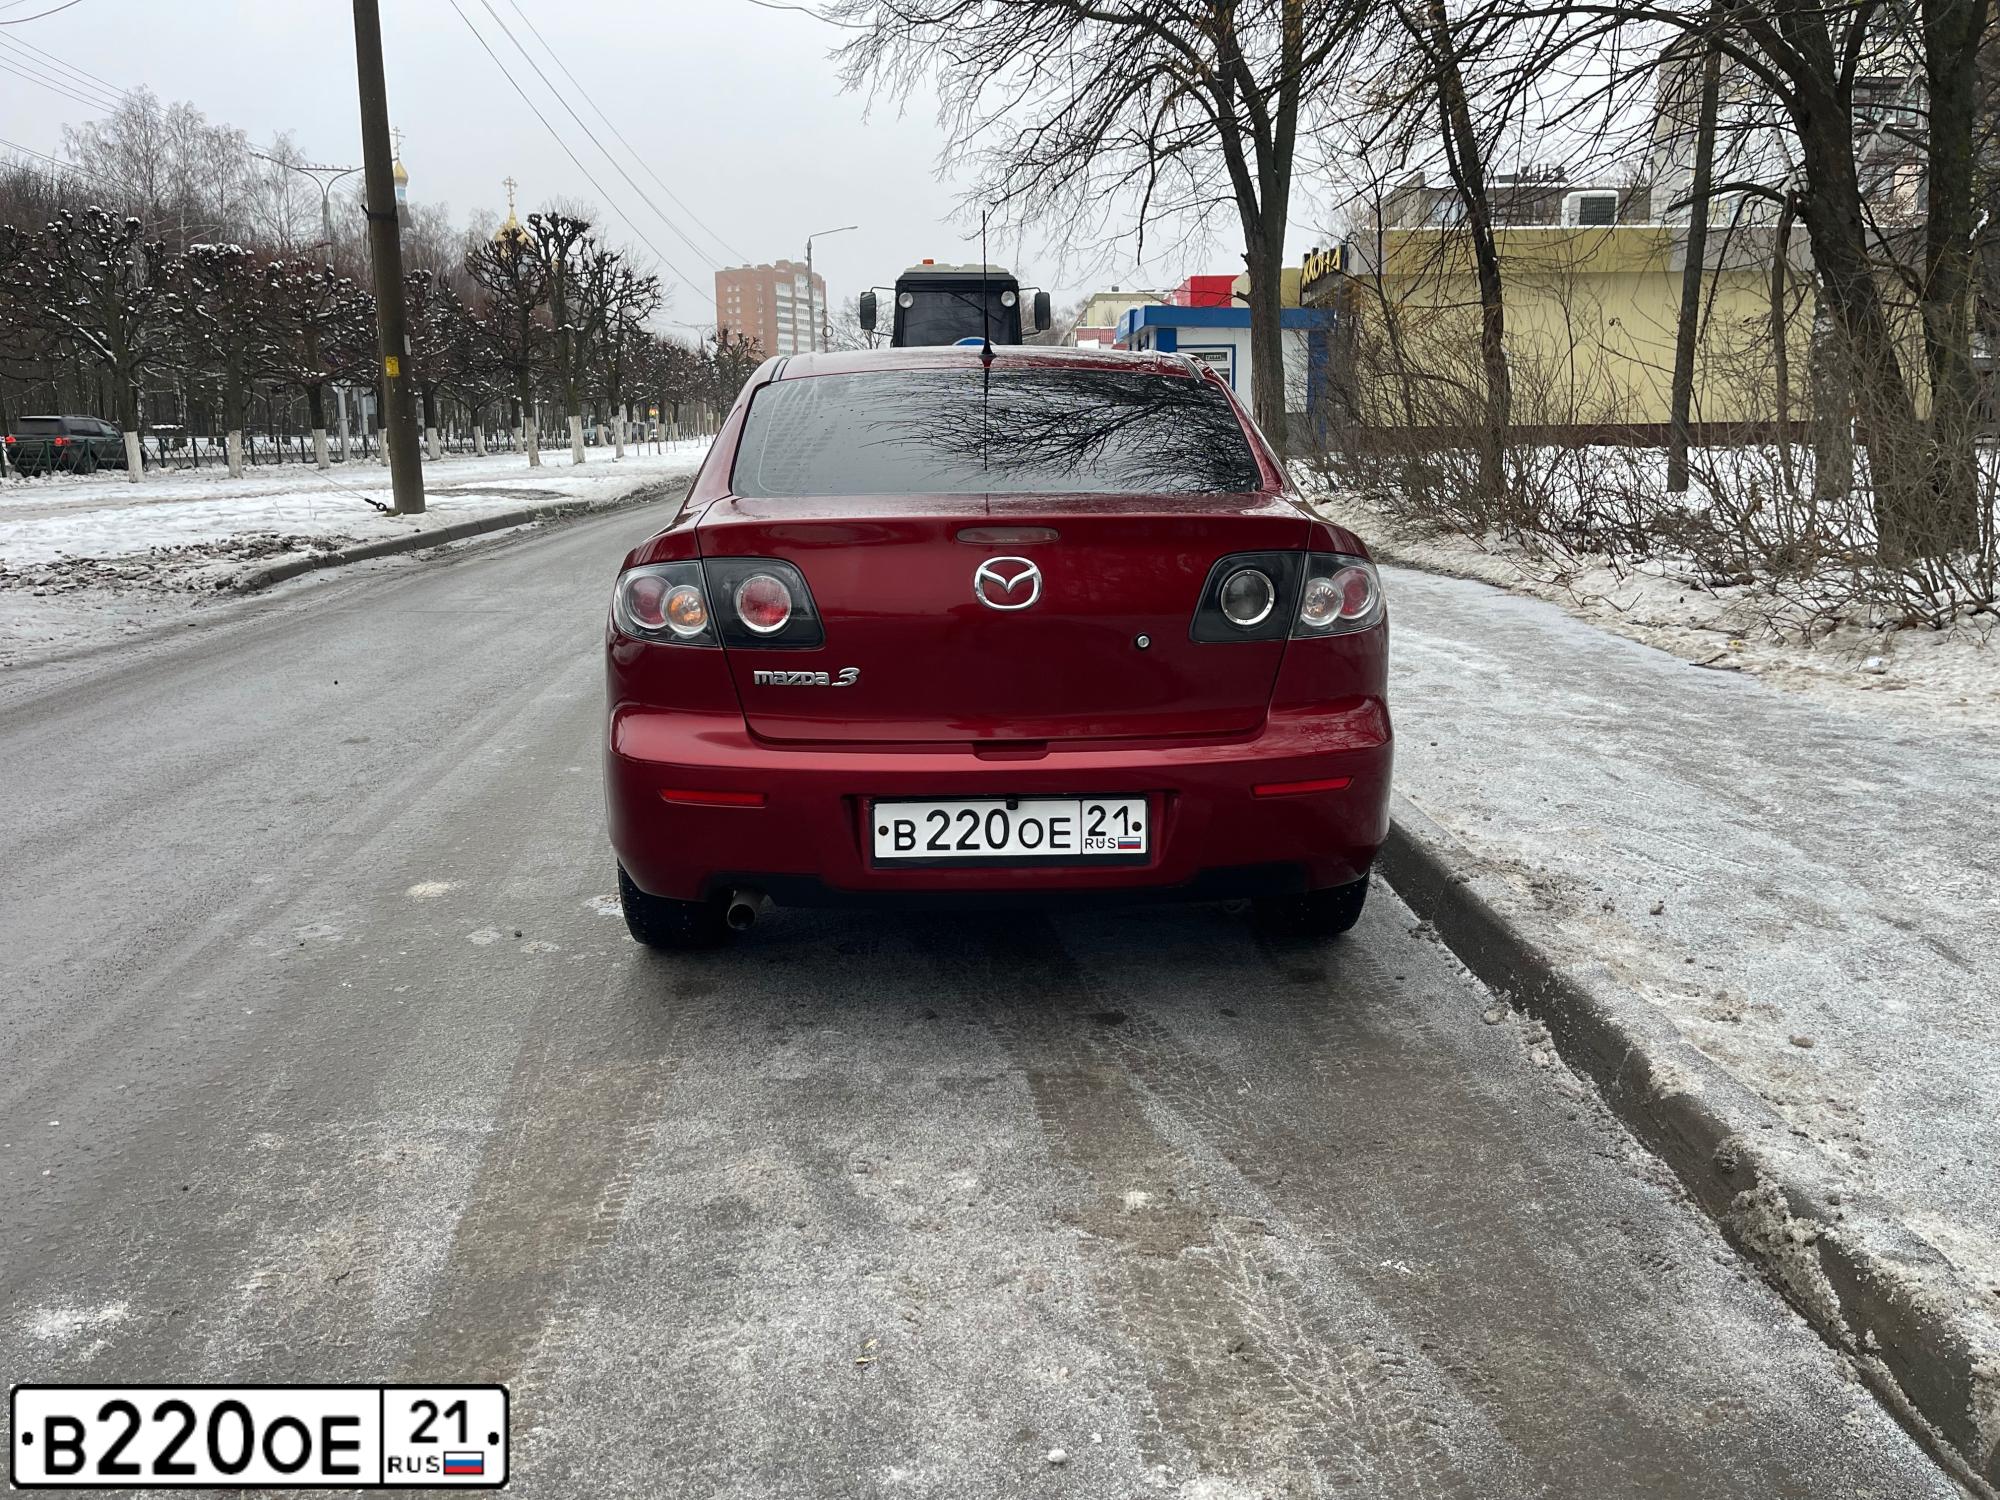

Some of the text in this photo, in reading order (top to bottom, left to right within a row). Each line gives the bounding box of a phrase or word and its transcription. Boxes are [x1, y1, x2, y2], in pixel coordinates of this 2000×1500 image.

[831, 667, 861, 687] 3
[1087, 805, 1128, 837] 21
[1084, 837, 1117, 849] RUS
